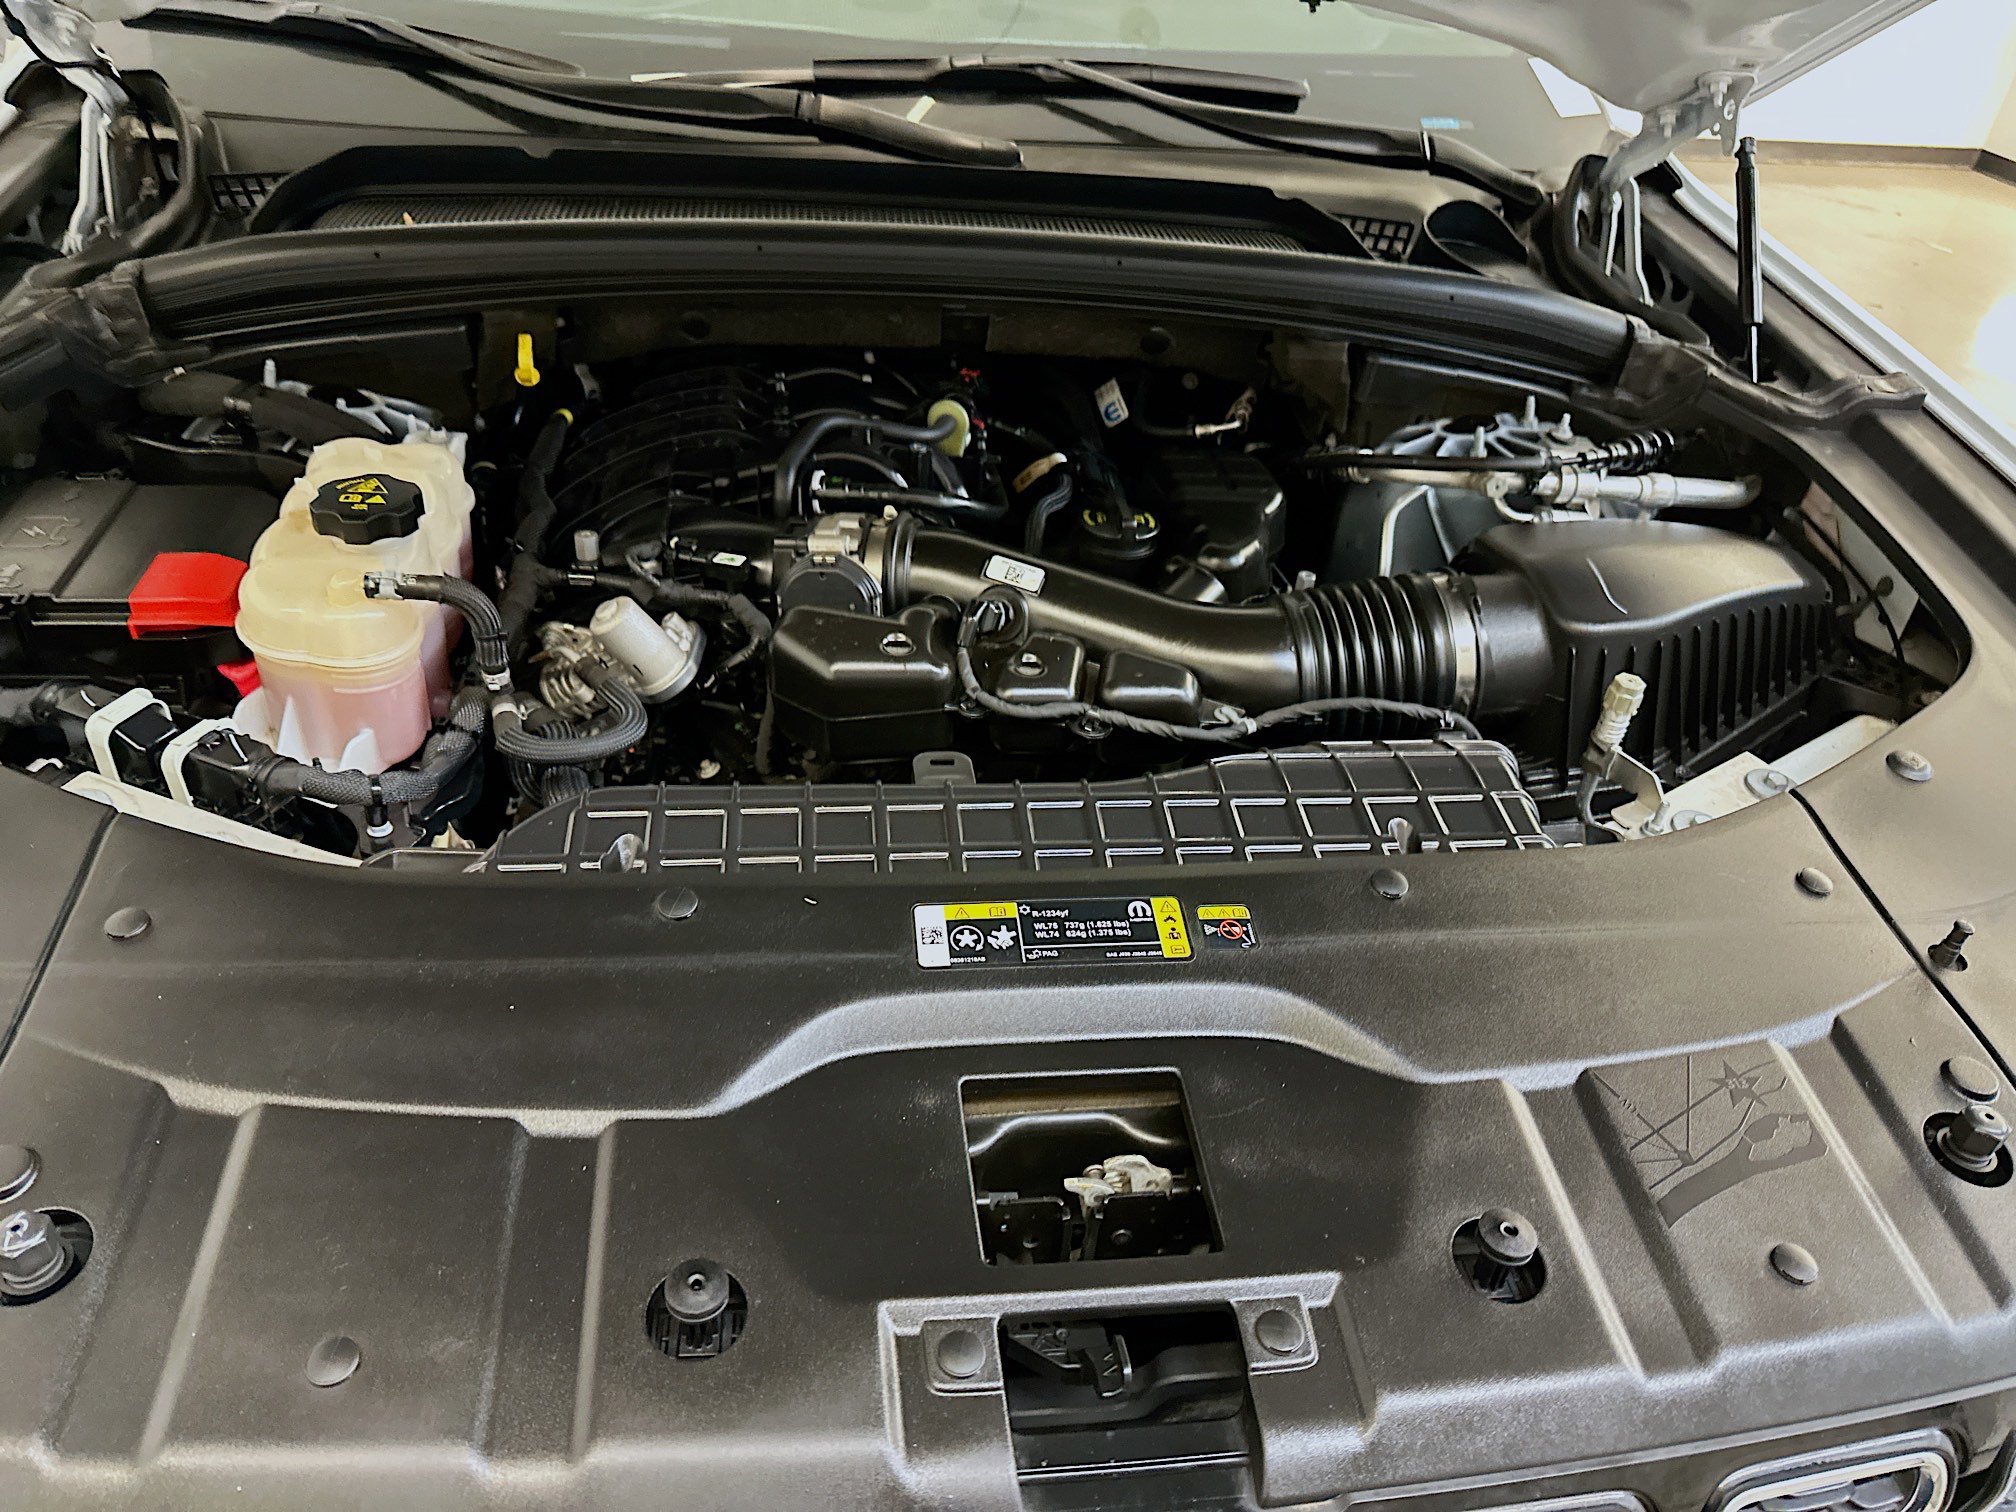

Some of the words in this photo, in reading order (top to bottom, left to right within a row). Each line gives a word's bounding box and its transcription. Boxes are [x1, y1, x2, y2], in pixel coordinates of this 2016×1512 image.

[1064, 921, 1086, 930] 737g
[1035, 930, 1060, 939] WL74
[1725, 1077, 1750, 1090] 313
